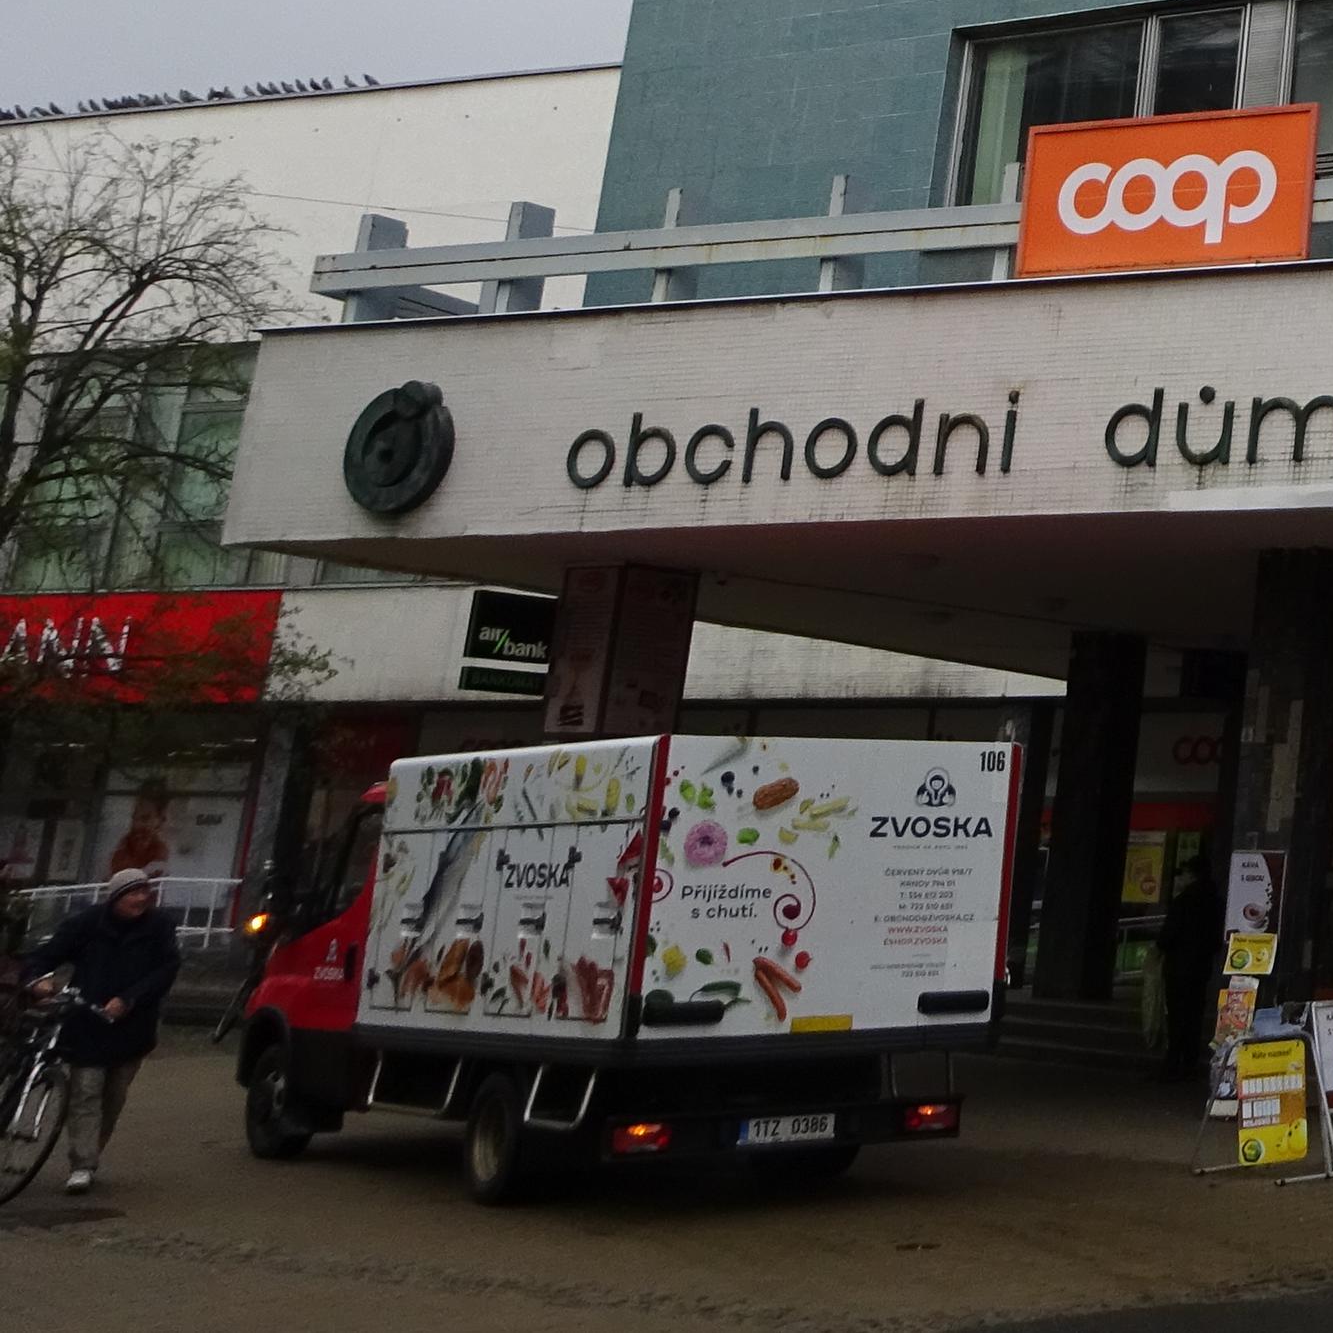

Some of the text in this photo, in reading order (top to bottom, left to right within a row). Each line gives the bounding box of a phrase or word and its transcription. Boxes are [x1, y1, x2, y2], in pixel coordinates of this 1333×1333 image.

[1057, 149, 1277, 244] coop
[501, 637, 548, 658] bank
[980, 750, 1006, 772] 106
[869, 816, 993, 838] ZVOSKA
[505, 862, 571, 889] ZVOSKA
[681, 883, 772, 902] Přijíždíme
[691, 903, 757, 918] s chutí.
[754, 1116, 828, 1137] 1TZ 0386
